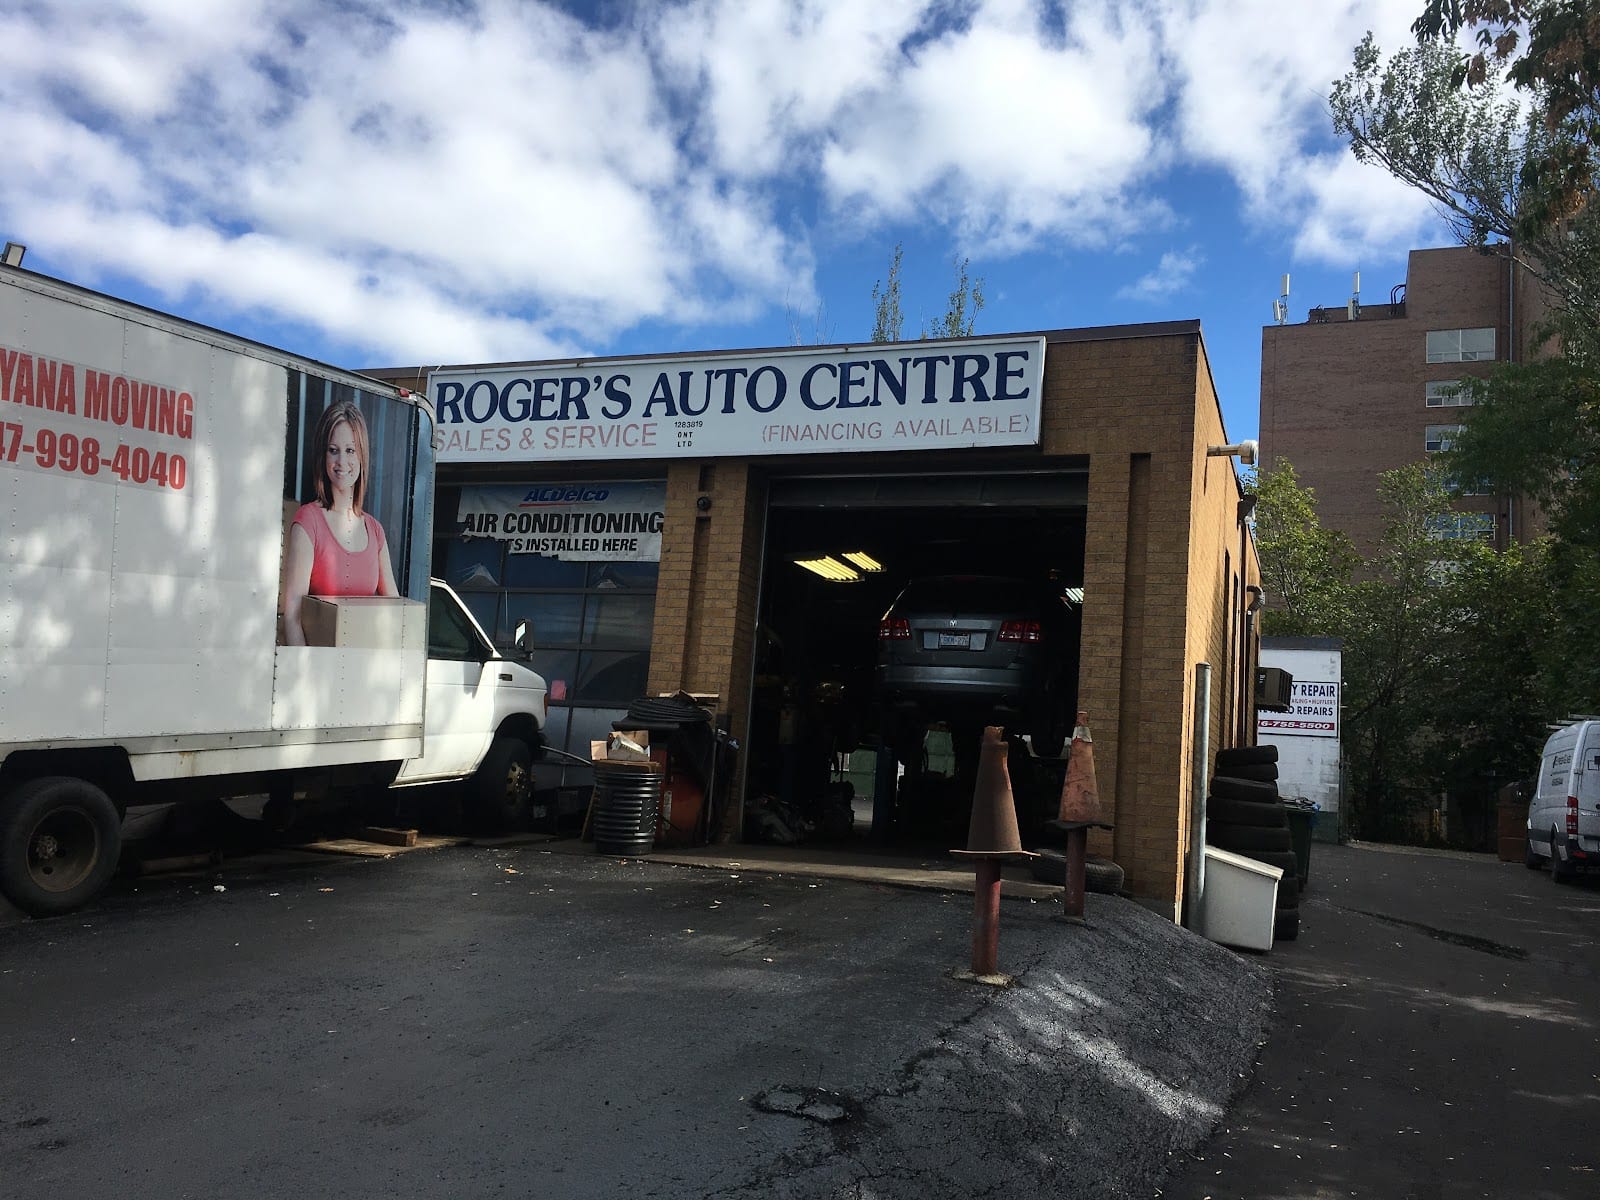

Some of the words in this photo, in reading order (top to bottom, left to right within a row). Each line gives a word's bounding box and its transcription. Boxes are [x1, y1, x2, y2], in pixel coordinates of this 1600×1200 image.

[436, 374, 632, 424] ROGER'S
[642, 364, 787, 418] AUTO
[799, 350, 1030, 411] CENTRE
[84, 369, 193, 440] MOVING
[674, 420, 703, 429] 1283819
[762, 420, 883, 443] (FINANCING
[893, 414, 1030, 439] AVAILABLE)
[435, 427, 511, 452] SALES
[518, 426, 536, 450] &
[544, 422, 658, 450] SERVICE
[464, 513, 498, 533] AIR
[502, 512, 664, 534] CONDITIONING
[526, 538, 598, 552] INSTALLED
[602, 537, 638, 551] HERE
[1301, 684, 1336, 697] REPAIR
[1296, 706, 1333, 716] REPAIRS
